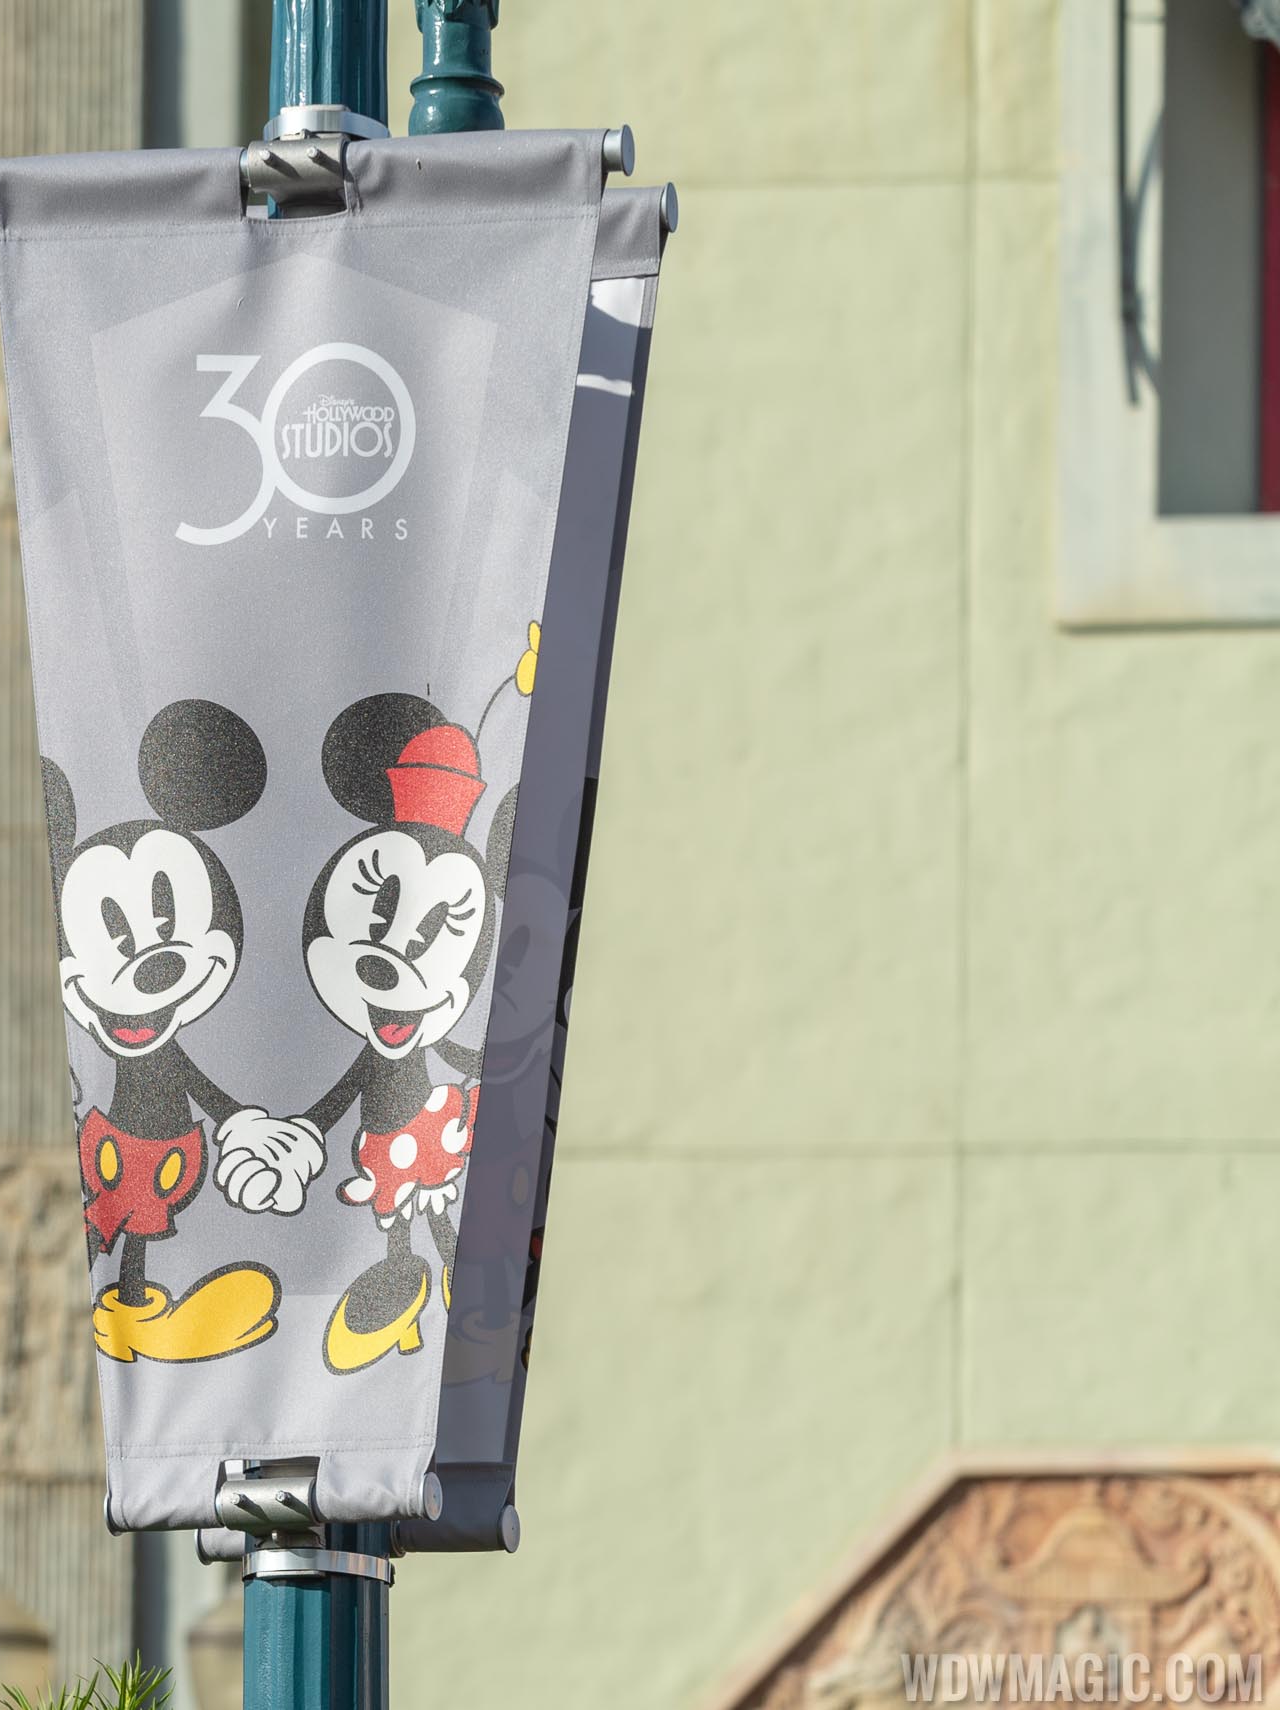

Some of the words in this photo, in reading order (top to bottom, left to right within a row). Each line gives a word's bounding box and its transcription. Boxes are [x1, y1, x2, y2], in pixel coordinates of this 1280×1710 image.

[302, 403, 395, 424] HOLLYWOOD
[175, 342, 417, 545] 30
[281, 422, 394, 459] STUDIOS
[262, 517, 408, 540] YEARS
